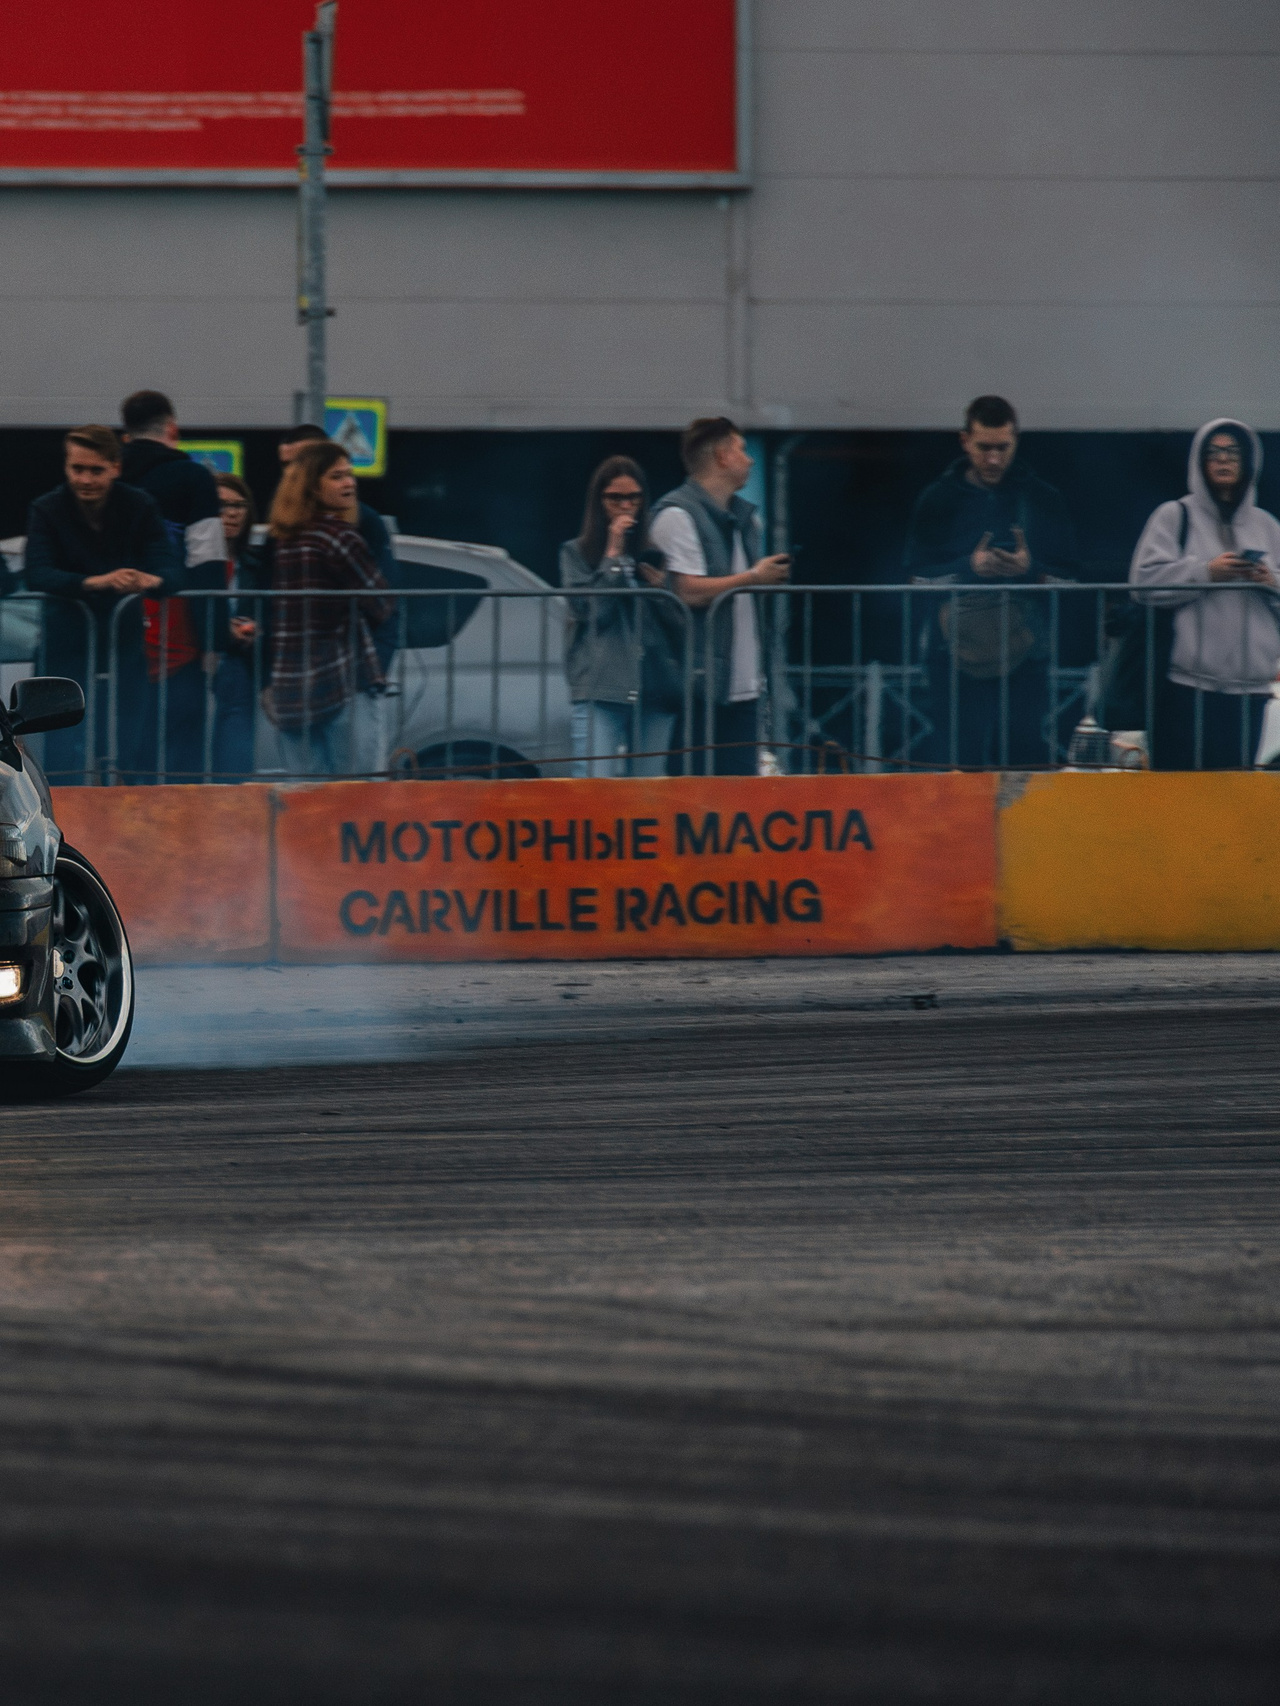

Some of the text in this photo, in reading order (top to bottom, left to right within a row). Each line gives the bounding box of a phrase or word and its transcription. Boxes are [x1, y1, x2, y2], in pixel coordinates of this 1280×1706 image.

[340, 809, 874, 863] МОТОРНЫЕ МАСЛА
[339, 878, 822, 935] CARVILLE RACING
